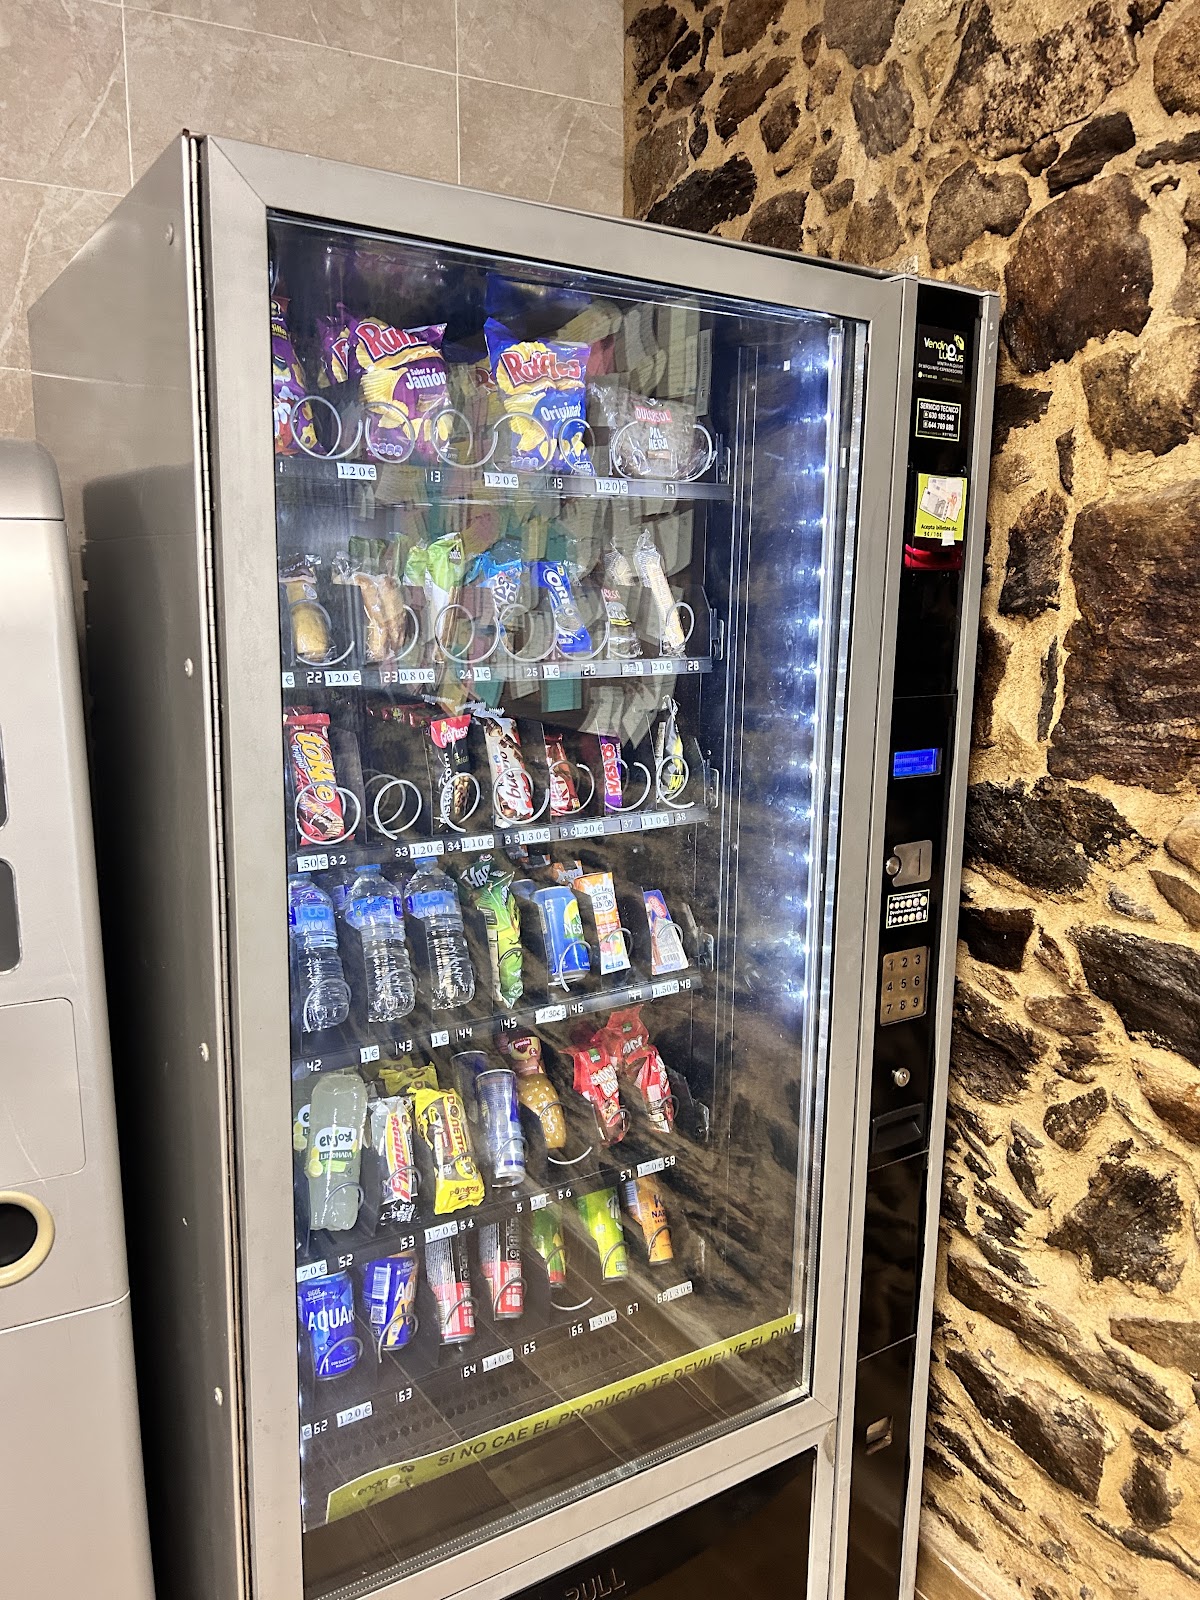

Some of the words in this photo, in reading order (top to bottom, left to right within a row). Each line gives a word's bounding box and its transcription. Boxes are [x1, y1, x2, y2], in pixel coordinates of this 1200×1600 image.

[500, 350, 582, 388] Ruffles
[405, 367, 447, 390] Jamón
[540, 401, 582, 422] Original
[920, 402, 941, 412] SERVICIO
[430, 470, 441, 483] 13
[526, 667, 538, 677] 25
[687, 660, 699, 671] 28
[306, 671, 322, 684] 22
[383, 671, 398, 683] 23
[459, 669, 473, 680] 24
[676, 812, 686, 821] 38
[623, 820, 633, 829] 37
[395, 847, 409, 857] 33
[447, 841, 461, 851] 34
[889, 959, 894, 972] 1
[902, 957, 908, 968] 2
[915, 954, 920, 965] 3
[680, 978, 691, 989] 48
[887, 981, 893, 991] 4
[901, 979, 906, 989] 5
[914, 975, 920, 986] 6
[571, 1002, 584, 1012] 46
[886, 1003, 892, 1014] 7
[900, 1000, 906, 1011] 8
[913, 997, 919, 1008] 9
[504, 1019, 517, 1029] 45
[459, 1027, 473, 1038] 44
[398, 1039, 413, 1052] 43
[306, 1059, 322, 1072] 42
[319, 1130, 353, 1148] enjoy
[664, 1155, 676, 1168] 58
[401, 1235, 415, 1248] 53
[339, 1253, 354, 1268] 52
[657, 1292, 668, 1304] 68
[628, 1302, 640, 1315] 67
[571, 1323, 584, 1337] 66
[523, 1341, 536, 1355] 65
[463, 1363, 477, 1378] 64
[399, 1387, 413, 1403] 63
[437, 1451, 456, 1467] SI
[459, 1441, 487, 1460] NO
[492, 1426, 528, 1449] CAE
[532, 1418, 554, 1436] EL
[558, 1382, 648, 1425] PRODUCTO
[651, 1372, 670, 1389] TE
[673, 1342, 747, 1380] DEVUELVE
[314, 1420, 328, 1435] 62
